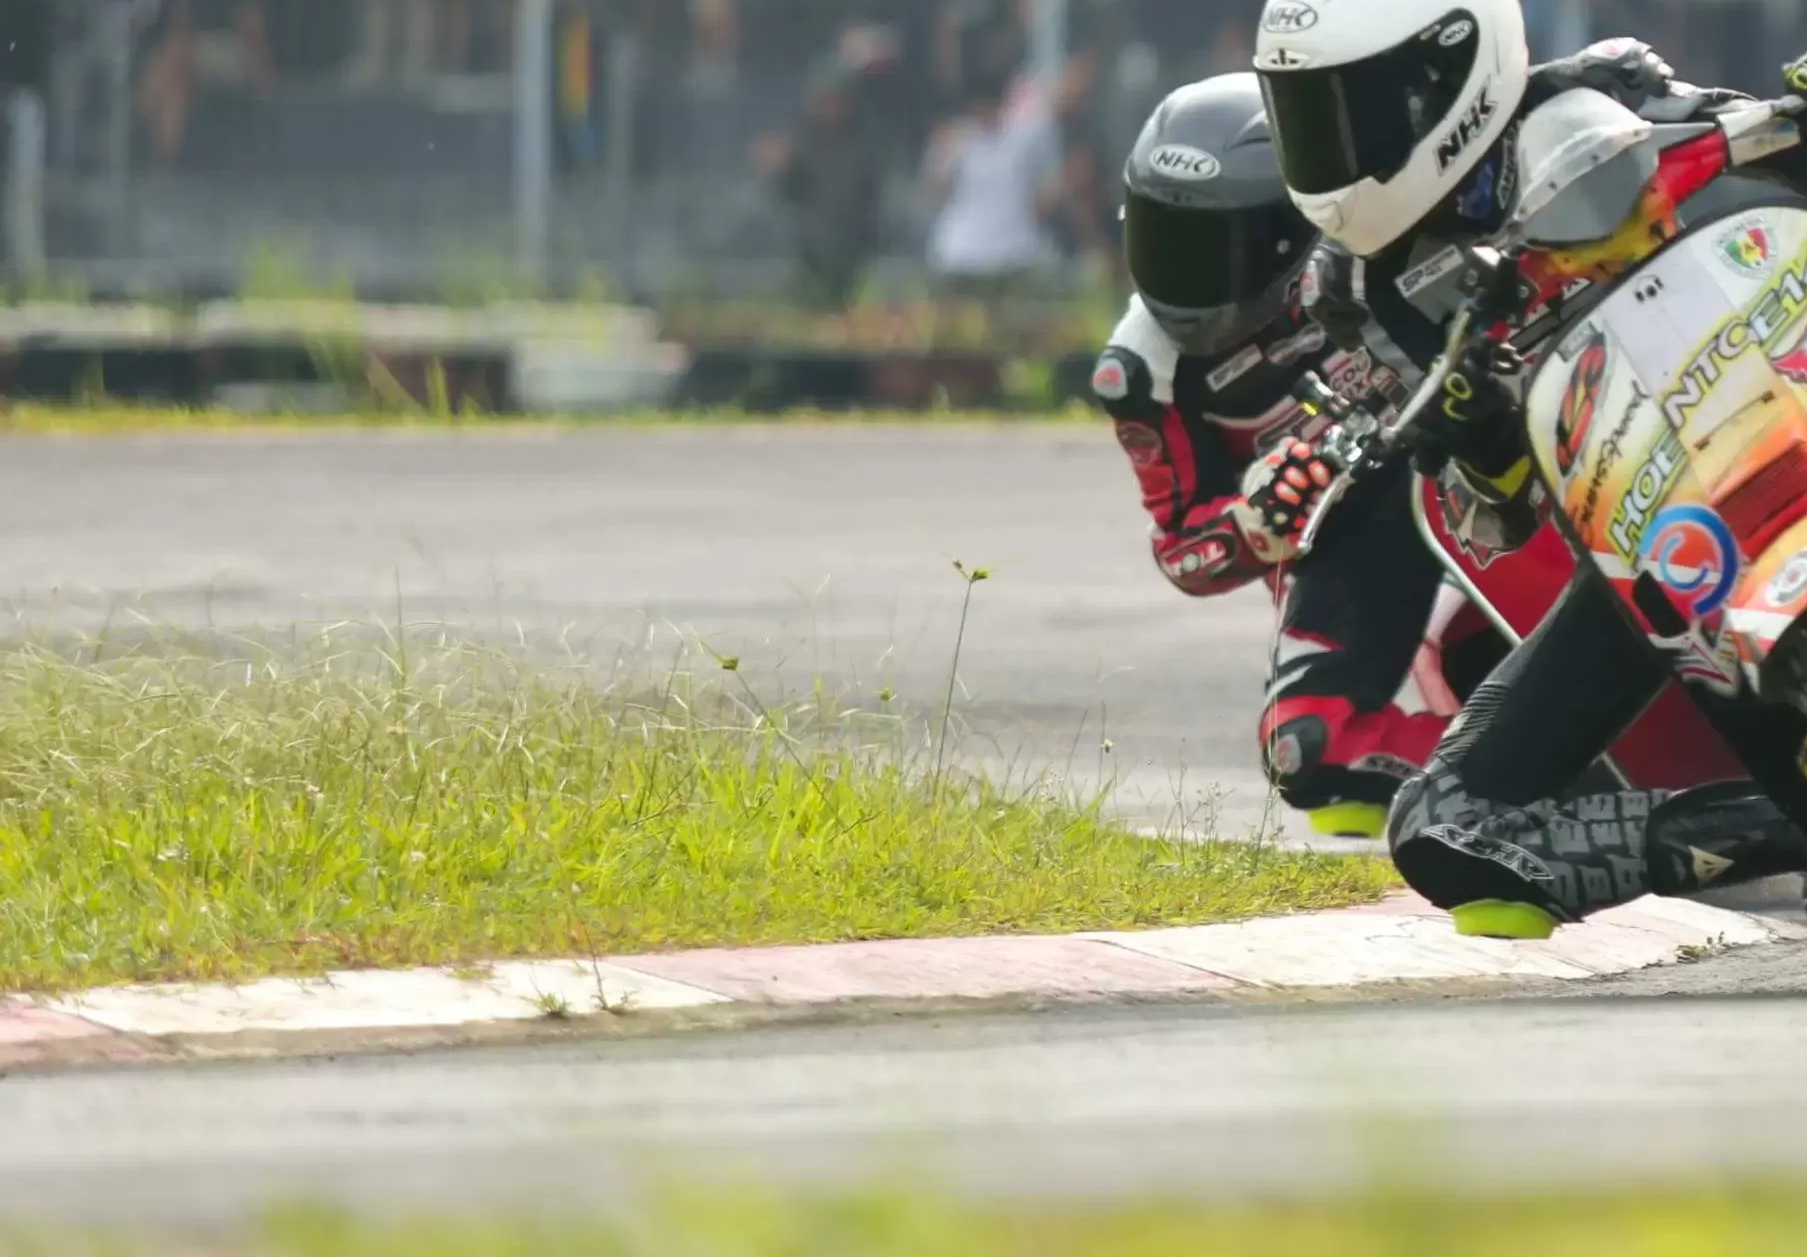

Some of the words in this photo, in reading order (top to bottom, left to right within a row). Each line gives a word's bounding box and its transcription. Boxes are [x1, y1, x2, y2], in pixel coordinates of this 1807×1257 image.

[1264, 4, 1316, 30] NHK
[1434, 77, 1496, 175] NHK
[1153, 148, 1216, 176] NHK
